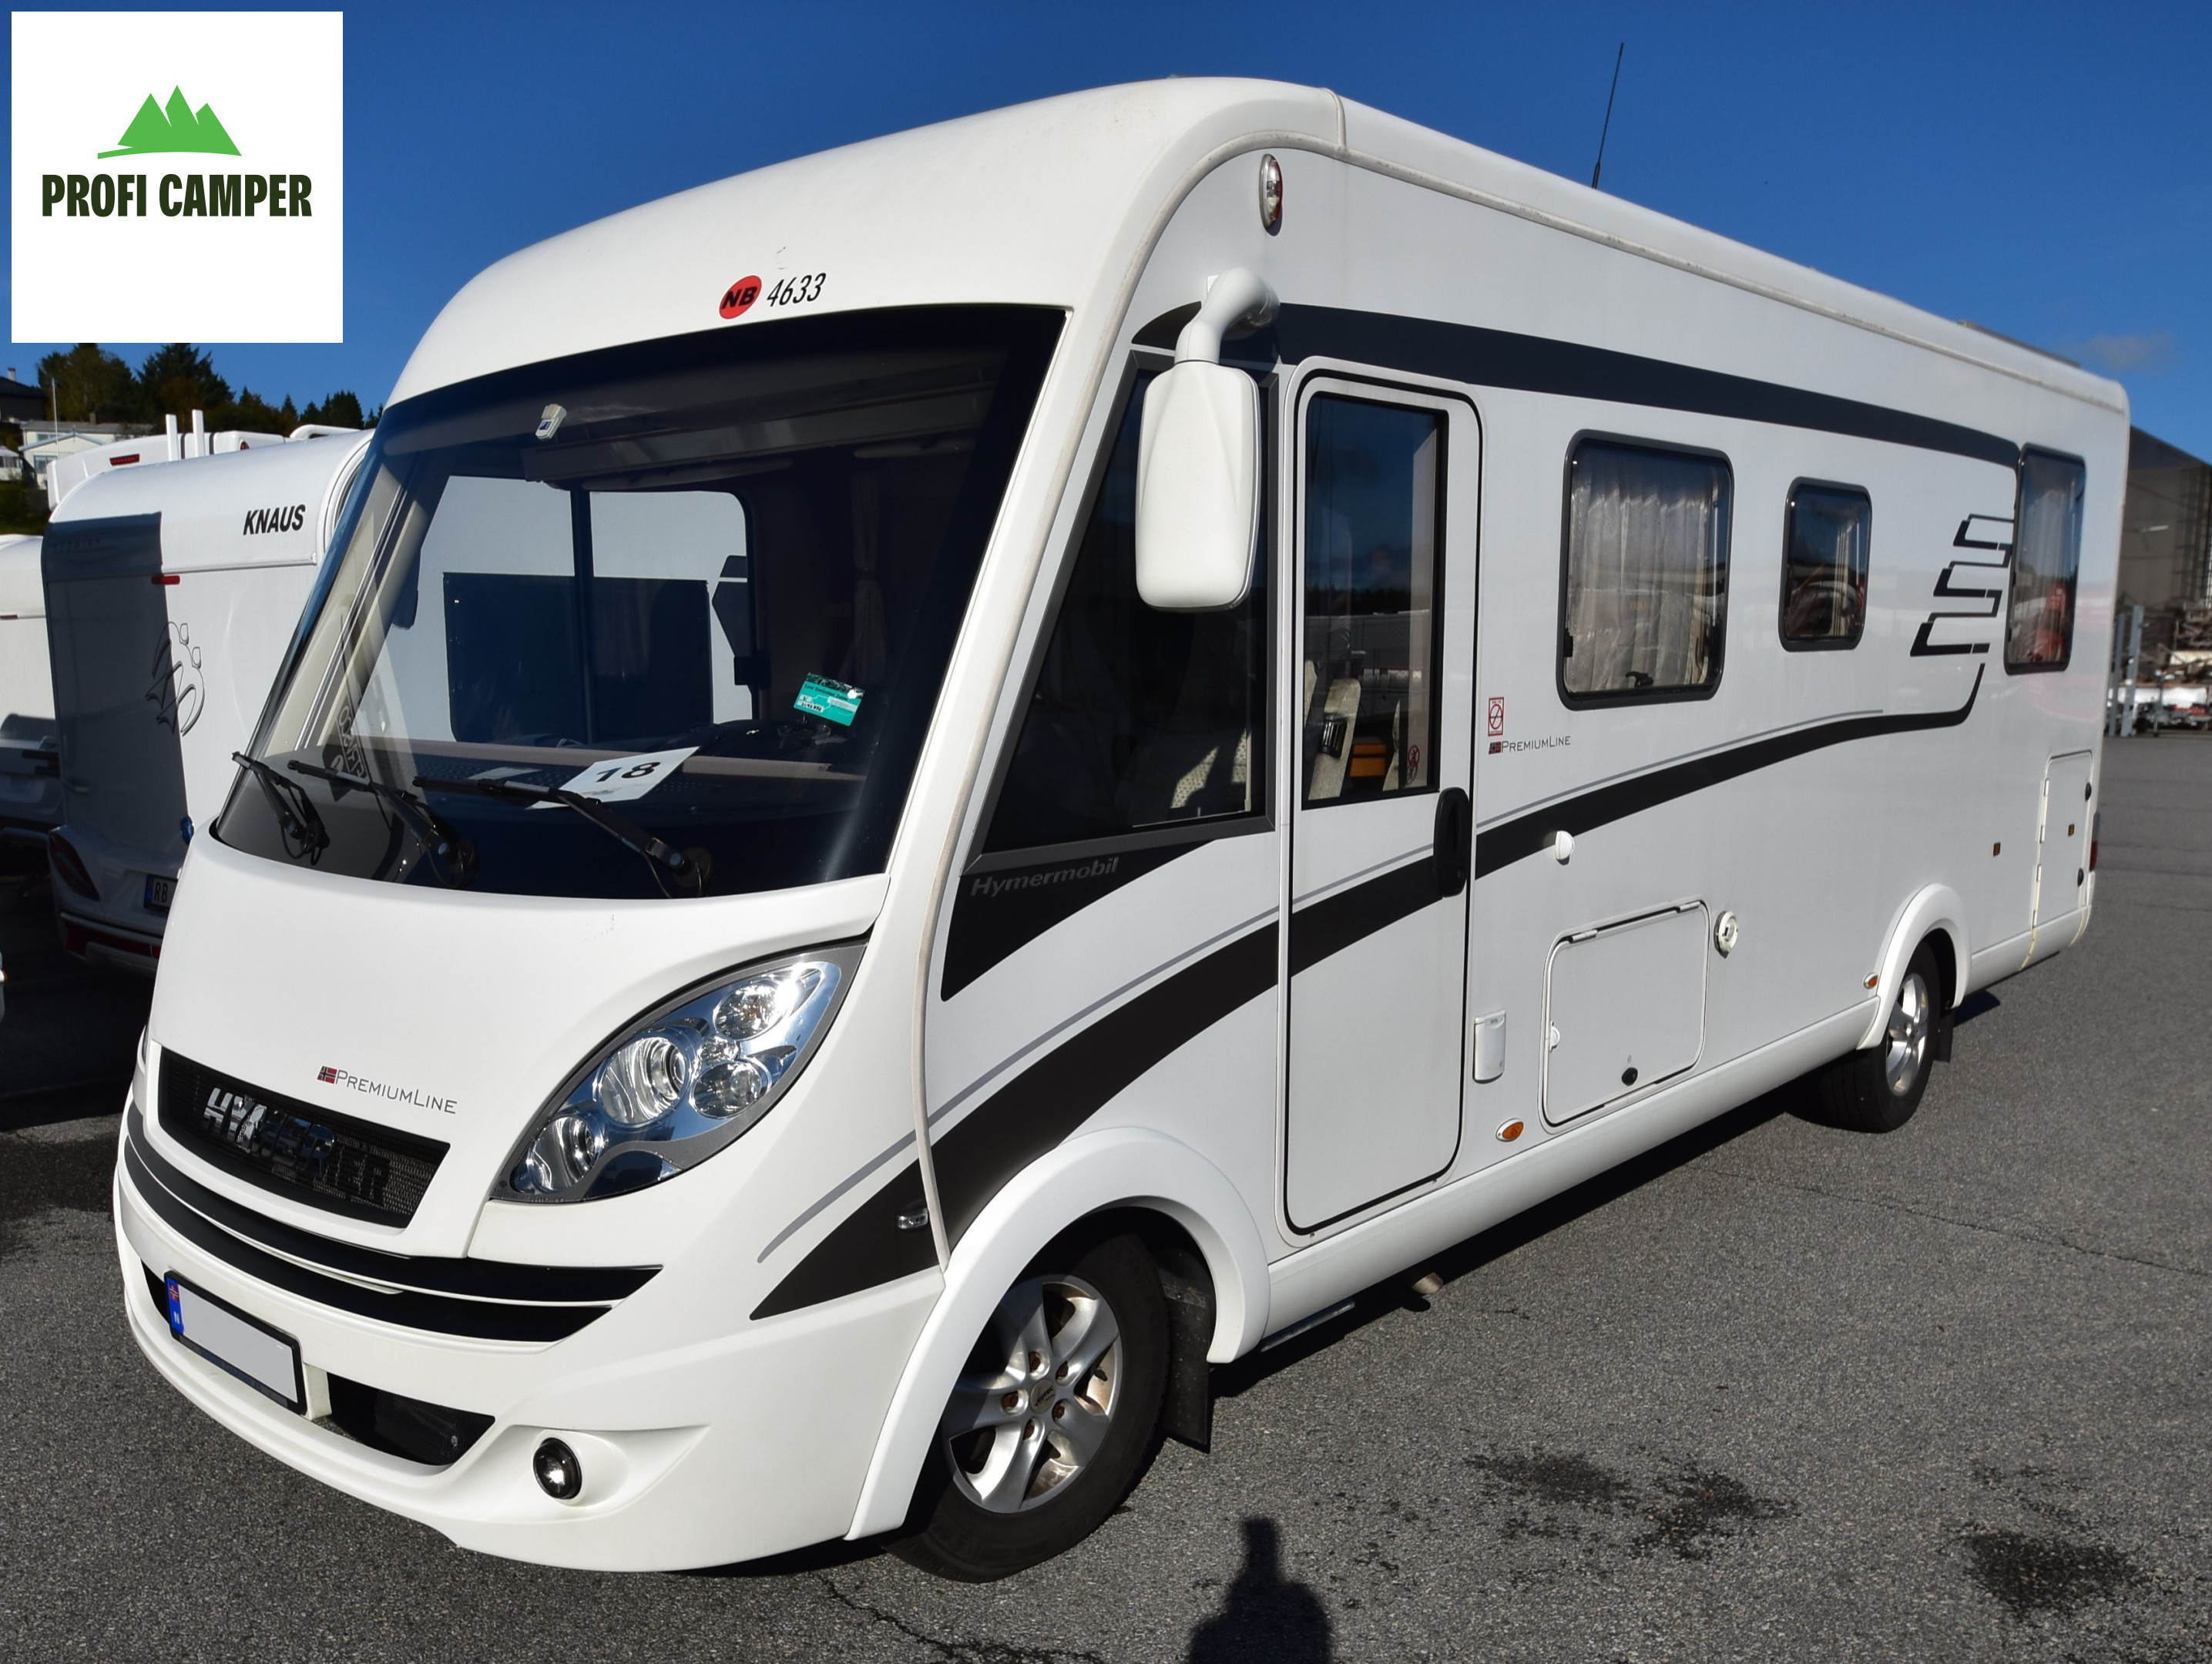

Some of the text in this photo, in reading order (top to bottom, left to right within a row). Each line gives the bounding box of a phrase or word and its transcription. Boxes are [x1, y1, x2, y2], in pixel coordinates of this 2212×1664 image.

[720, 272, 827, 310] NB 4633
[243, 504, 306, 535] KNAUS
[596, 761, 661, 783] 18
[970, 857, 1119, 897] Hymermobil
[154, 881, 169, 903] RB
[173, 1311, 180, 1324] N
